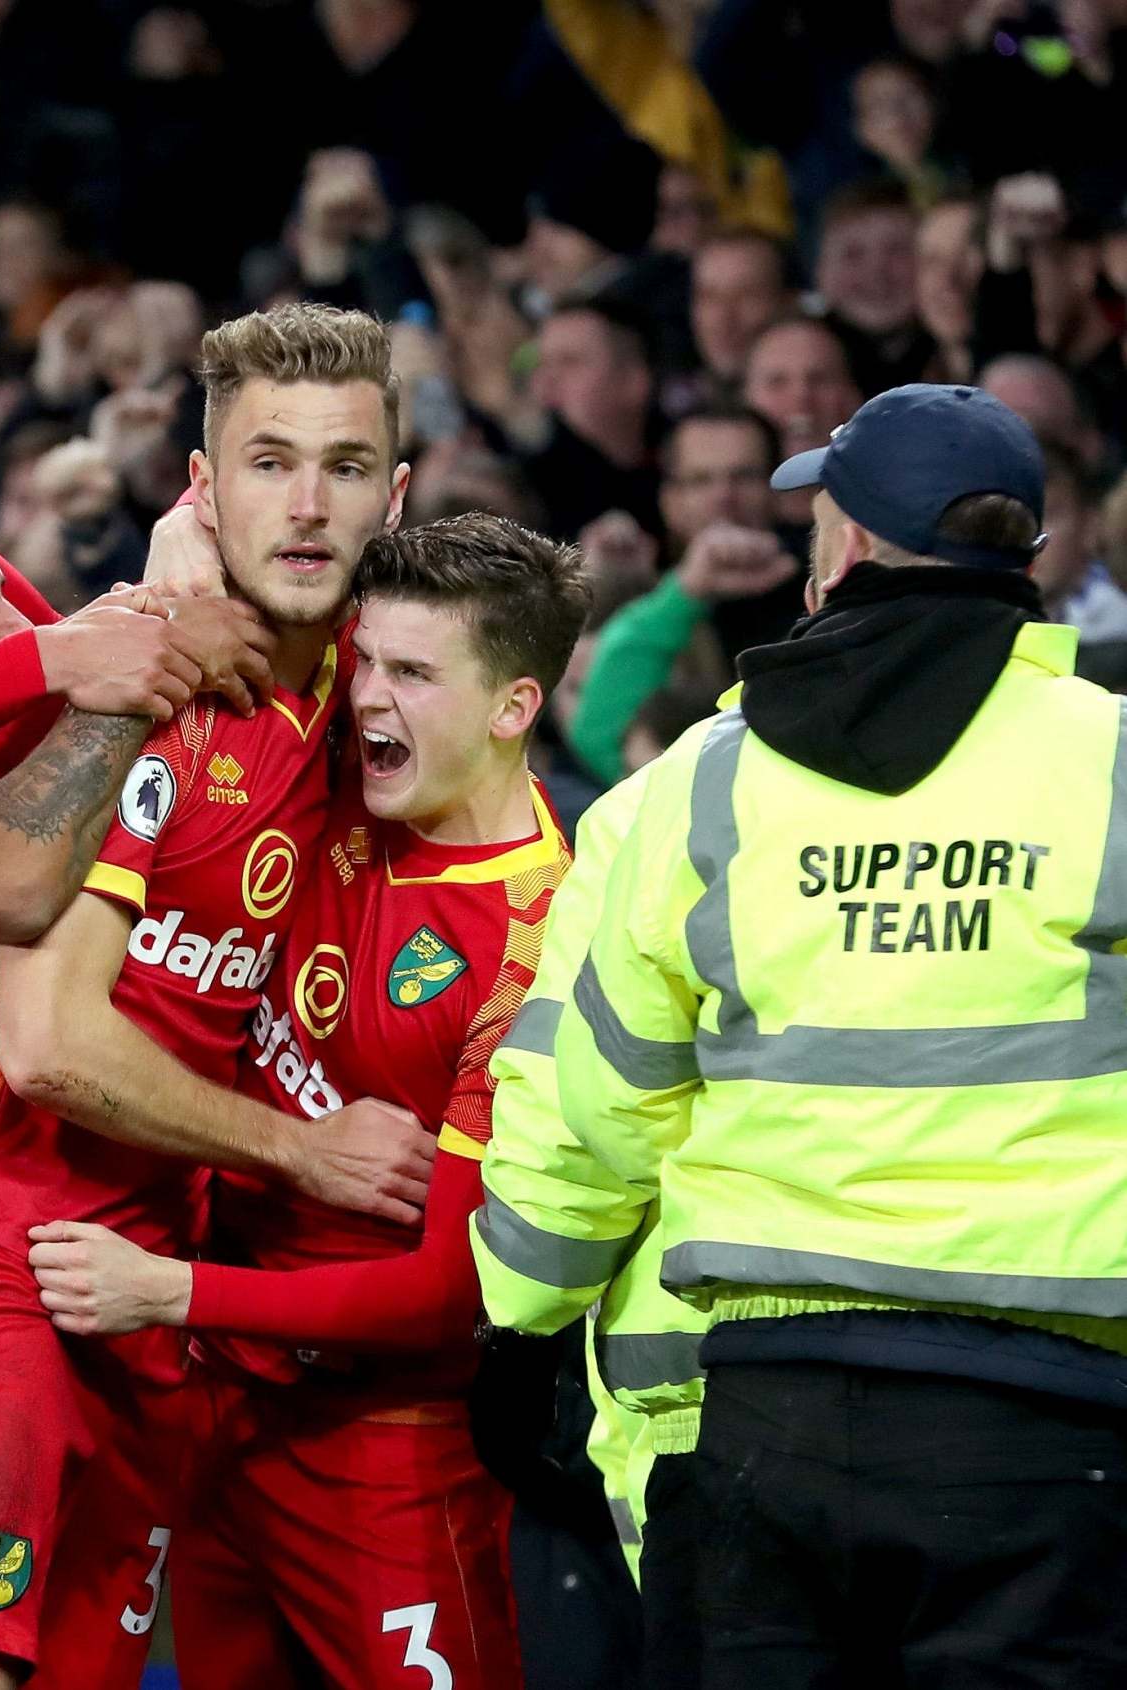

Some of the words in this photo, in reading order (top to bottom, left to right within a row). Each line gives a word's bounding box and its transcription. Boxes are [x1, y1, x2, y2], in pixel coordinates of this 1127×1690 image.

[799, 839, 1051, 897] SUPPORT
[838, 899, 992, 953] TEAM
[382, 1602, 453, 1690] 3
